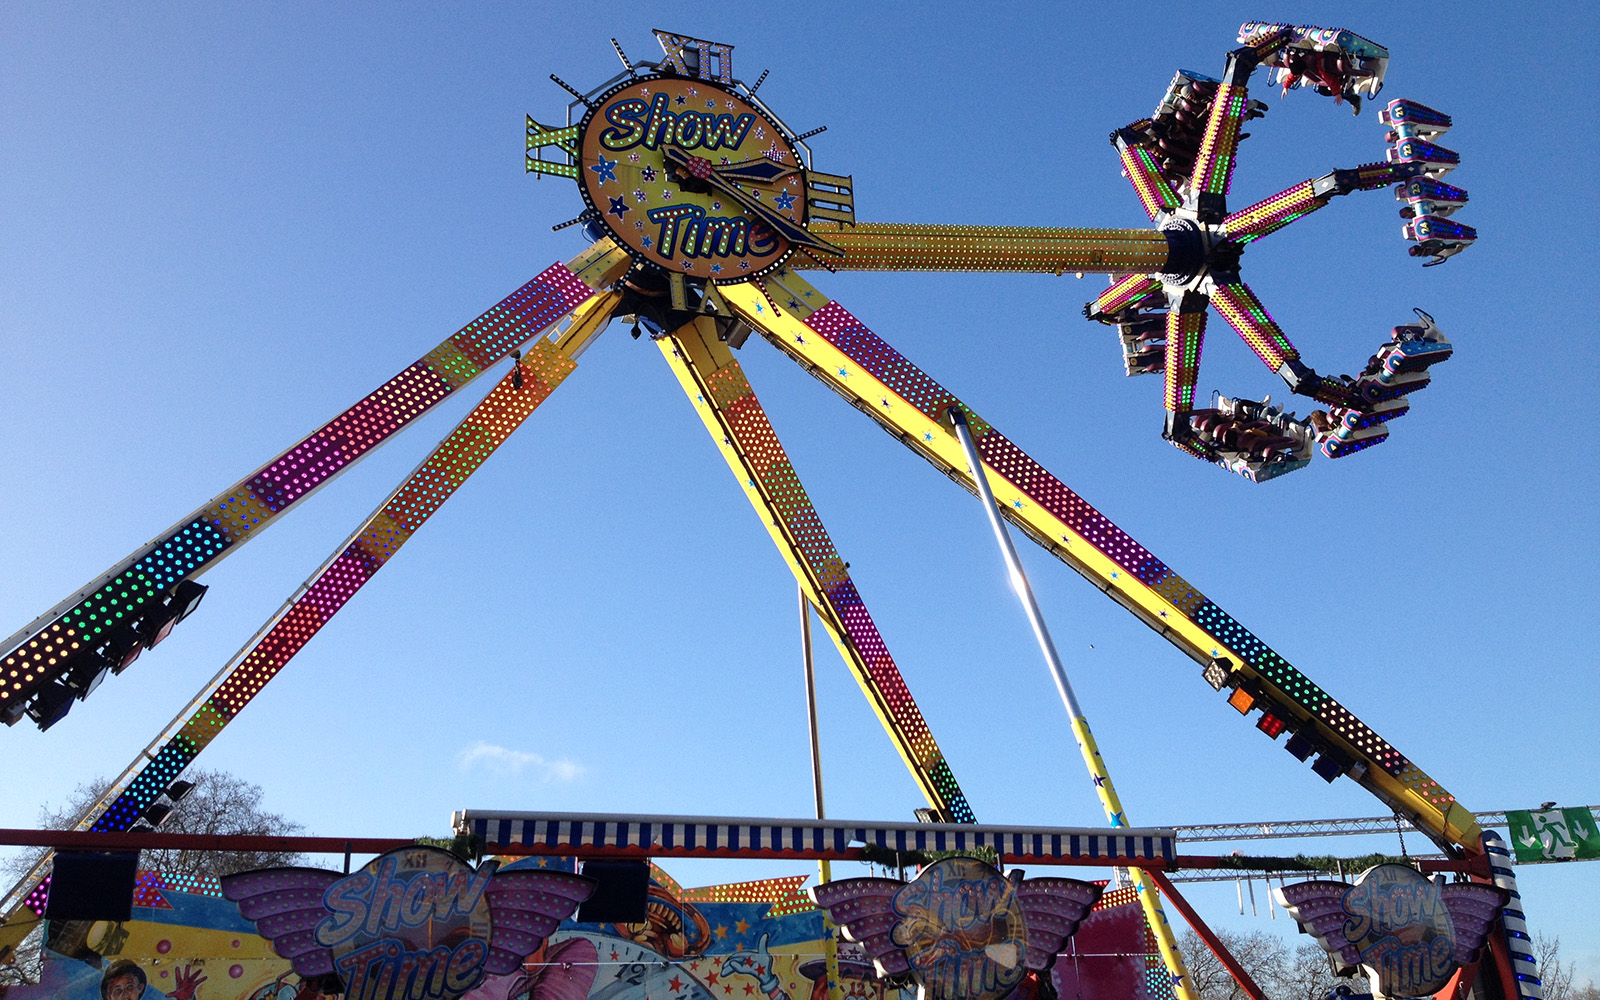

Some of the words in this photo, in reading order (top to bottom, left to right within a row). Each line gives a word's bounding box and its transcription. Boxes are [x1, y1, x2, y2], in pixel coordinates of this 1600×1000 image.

[651, 28, 735, 88] XII
[601, 93, 756, 151] Show
[1402, 144, 1413, 157] 22
[648, 204, 779, 260] Time
[1419, 221, 1431, 235] 24
[314, 856, 501, 948] Show
[889, 865, 1026, 948] Show
[1341, 871, 1447, 943] Show
[334, 938, 489, 1000] Time
[614, 960, 647, 986] 12
[1361, 935, 1453, 994] Time
